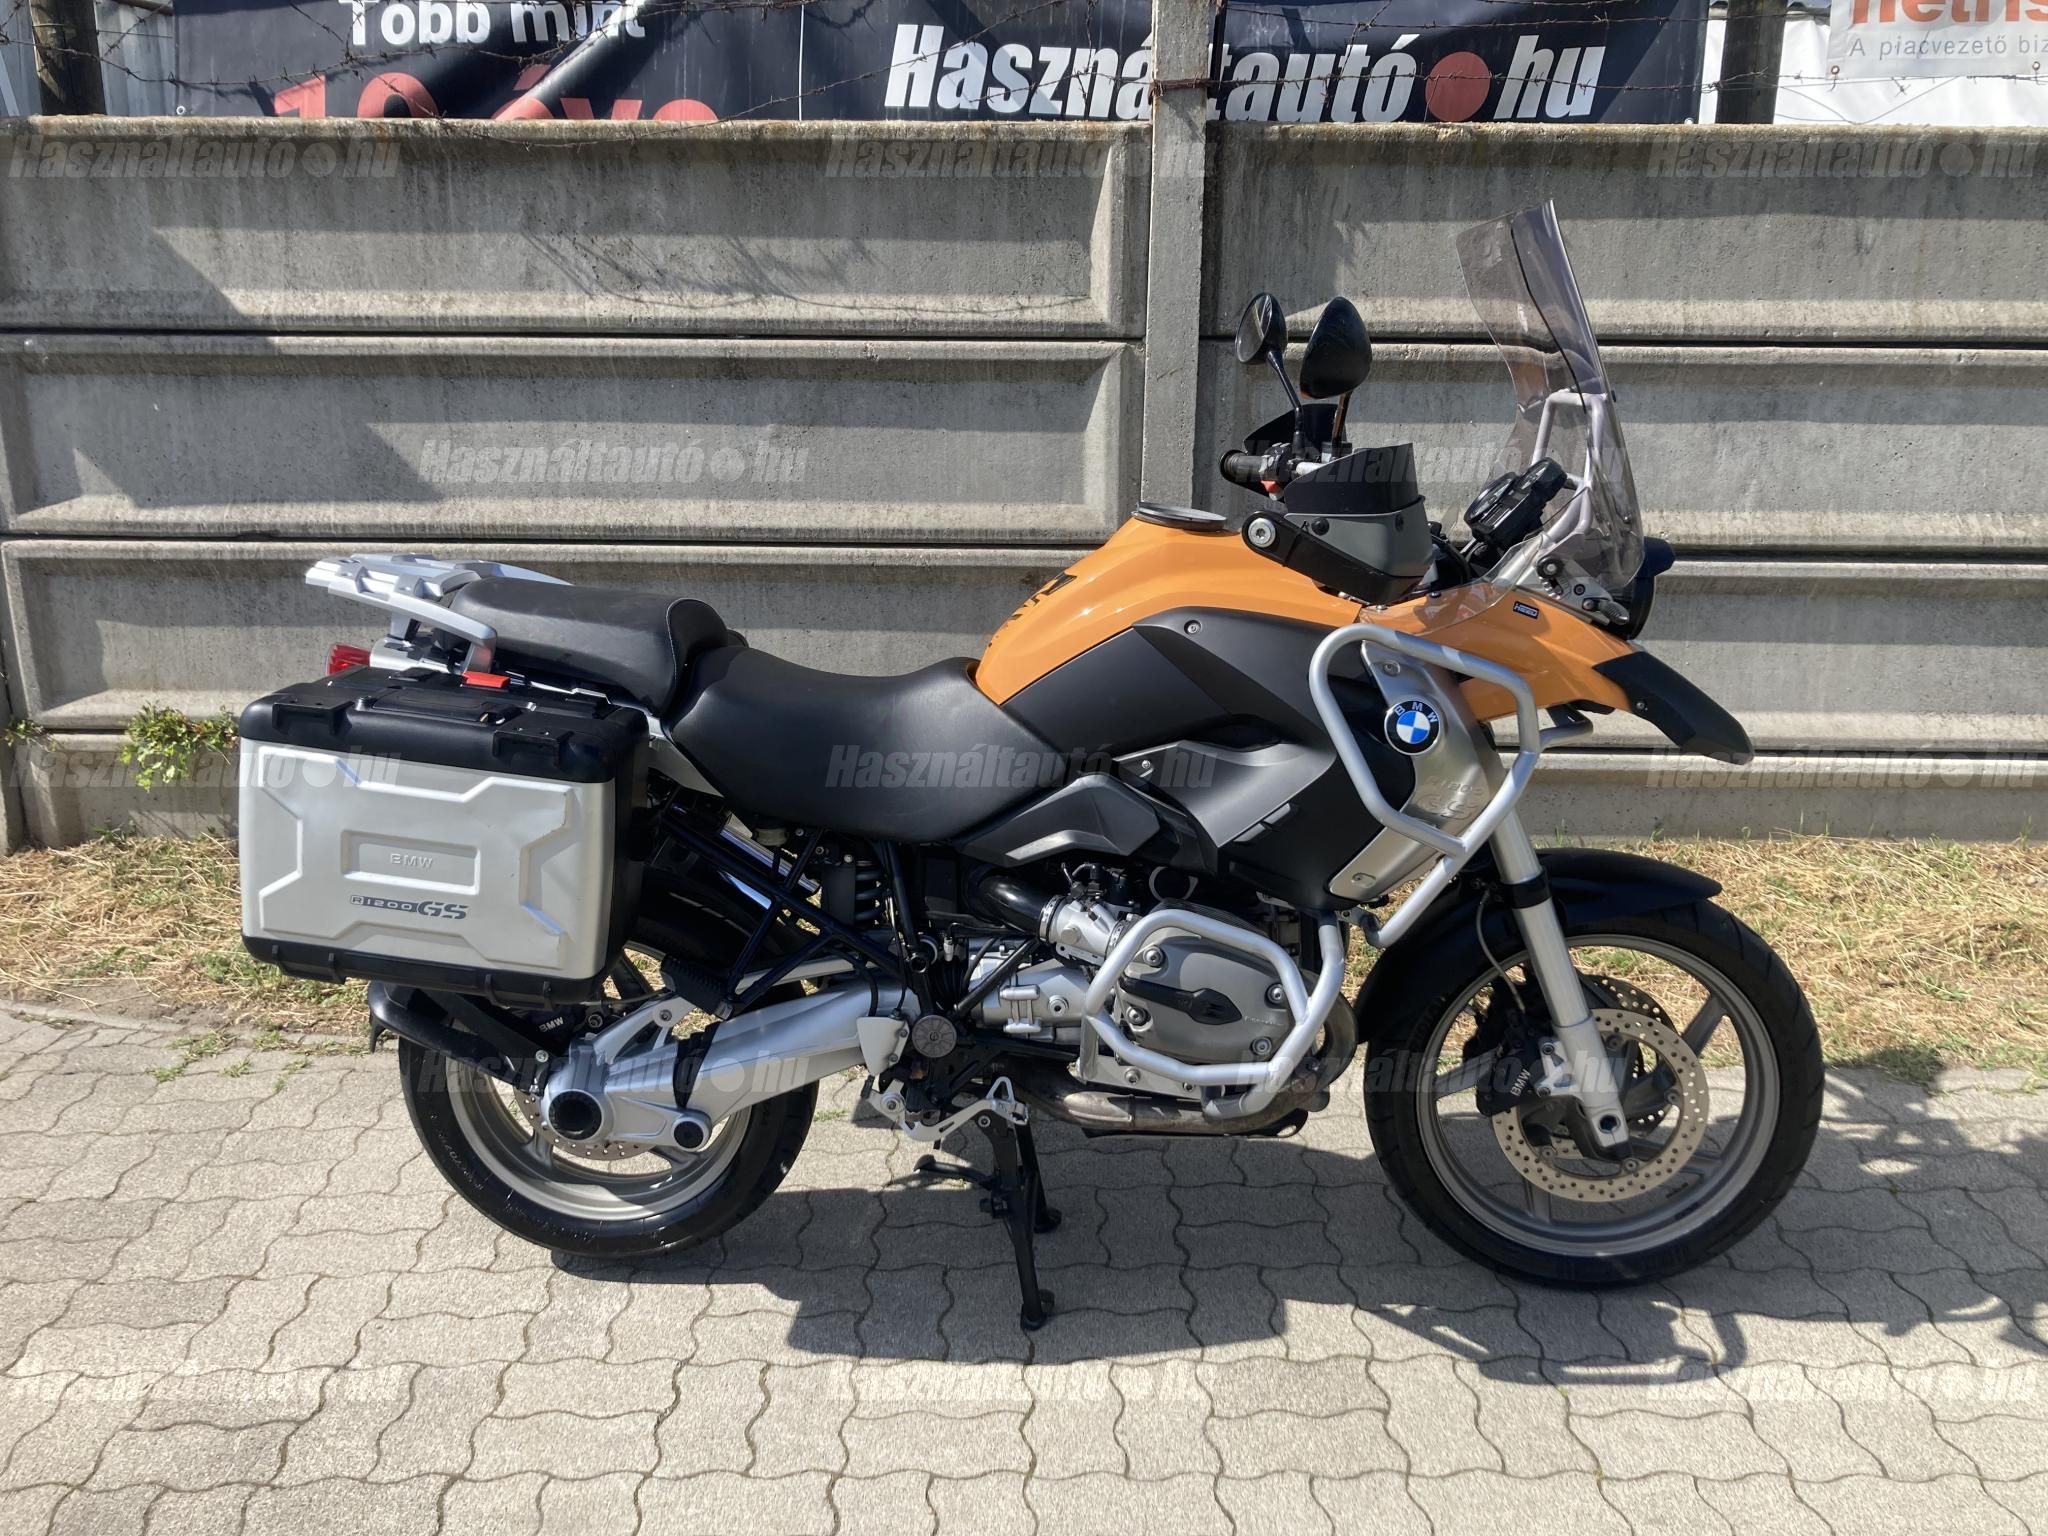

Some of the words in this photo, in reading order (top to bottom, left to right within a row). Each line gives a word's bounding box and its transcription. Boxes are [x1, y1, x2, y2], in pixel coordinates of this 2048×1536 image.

[1849, 38, 1866, 57] A
[1879, 34, 2007, 61] piacvezető
[1394, 701, 1438, 723] BMW
[390, 853, 433, 868] BMW
[539, 1016, 564, 1033] BMW
[1510, 1068, 1531, 1097] BMW
